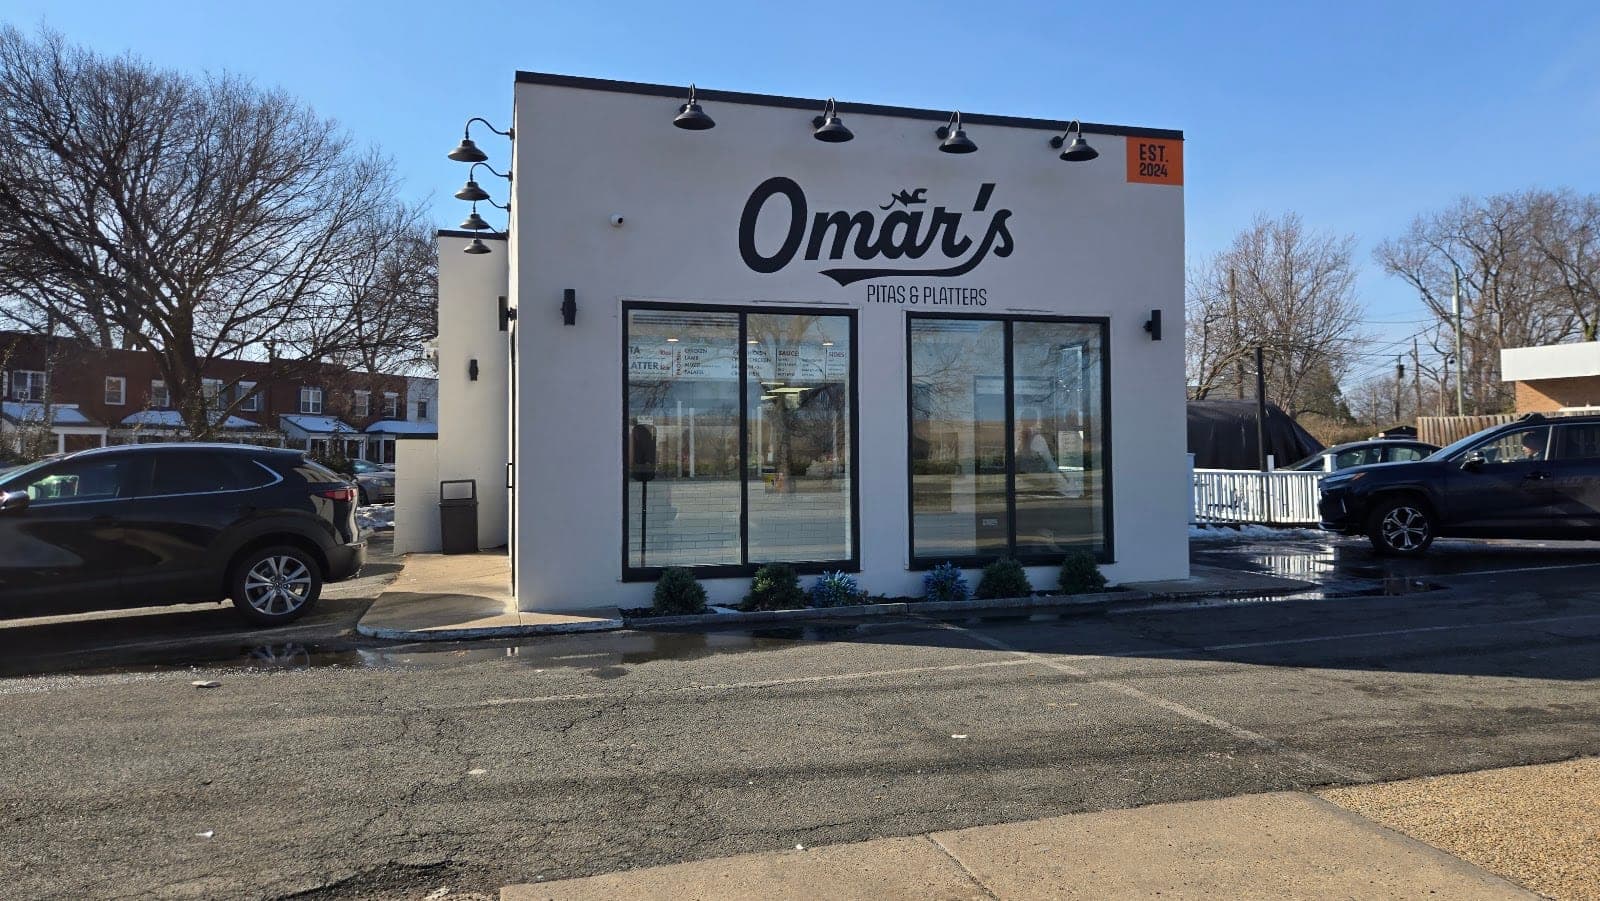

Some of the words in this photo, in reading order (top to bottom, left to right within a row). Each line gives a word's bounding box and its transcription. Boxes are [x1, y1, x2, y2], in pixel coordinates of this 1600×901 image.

[1139, 143, 1169, 162] EST.
[1139, 162, 1168, 178] 2024
[738, 176, 1014, 285] Omar's
[867, 284, 906, 304] PITAS
[909, 285, 919, 304] &
[923, 286, 987, 306] PLATTERS
